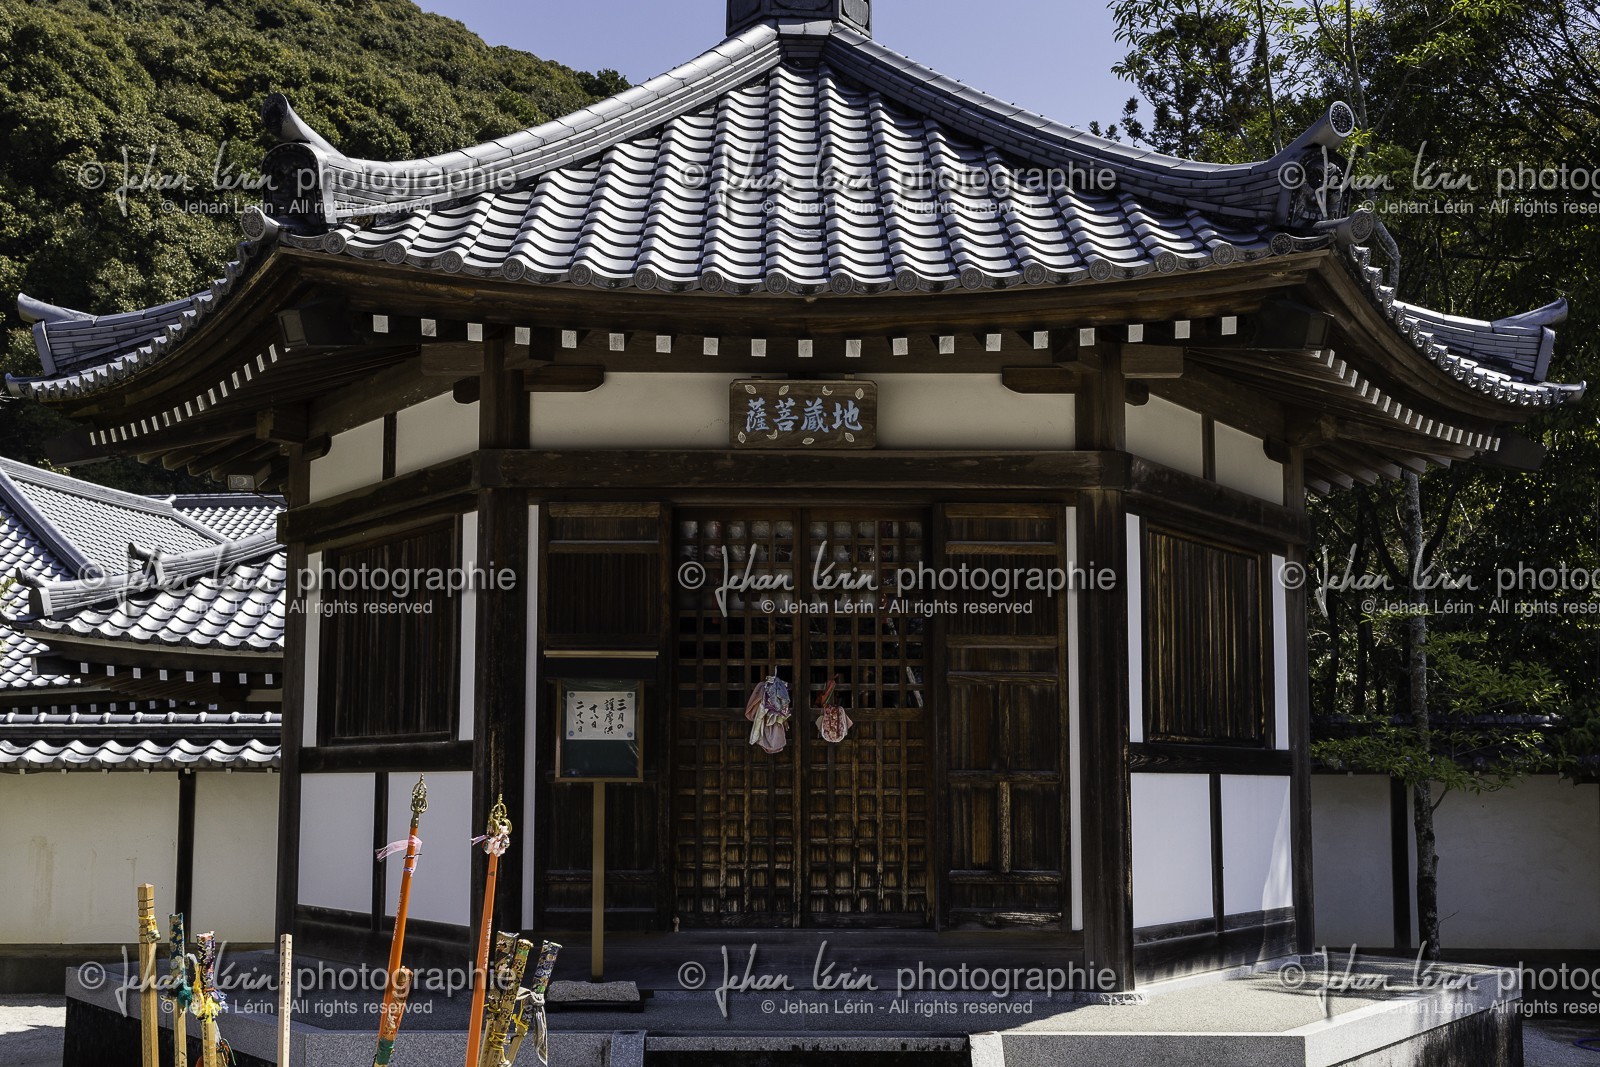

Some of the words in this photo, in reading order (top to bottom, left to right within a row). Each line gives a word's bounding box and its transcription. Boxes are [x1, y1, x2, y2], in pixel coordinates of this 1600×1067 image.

[576, 701, 584, 733] 二十八日
[589, 704, 599, 728] 十八日
[617, 698, 627, 729] 三月の
